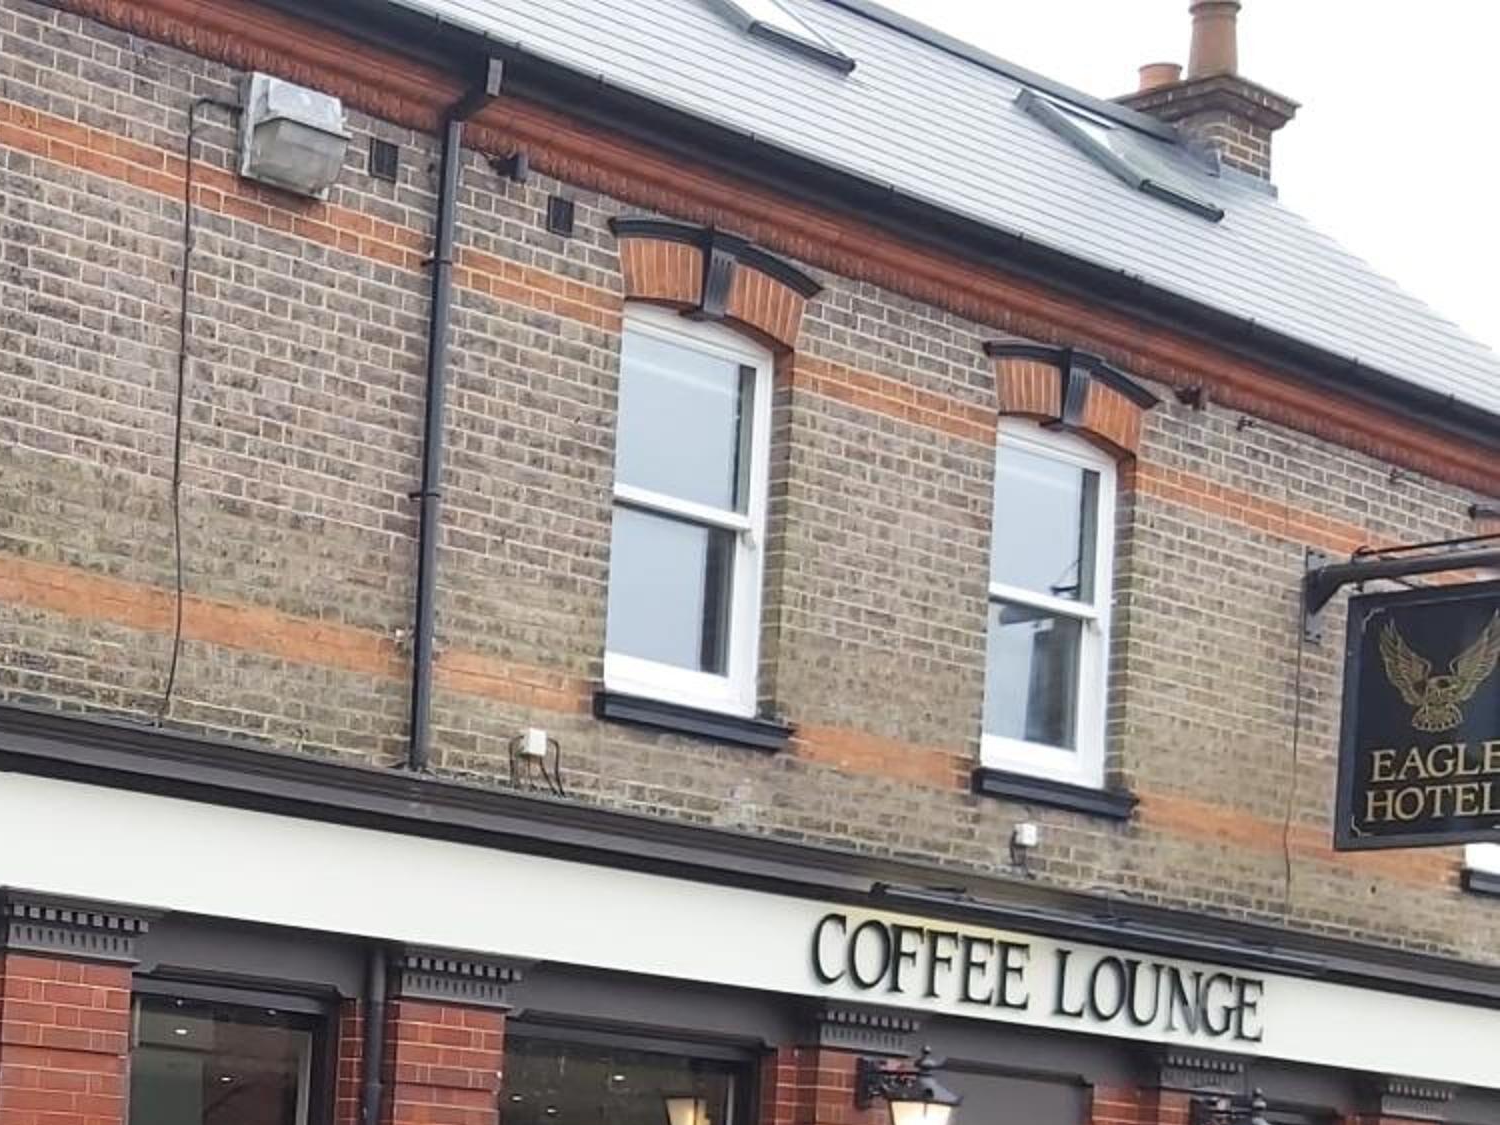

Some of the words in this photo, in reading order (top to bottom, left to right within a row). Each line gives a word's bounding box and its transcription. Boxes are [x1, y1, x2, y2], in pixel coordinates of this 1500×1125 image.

[1370, 740, 1500, 782] EAGLE
[1365, 781, 1500, 821] HOTEL
[811, 912, 1031, 1011] COFFEE
[1054, 947, 1265, 1043] LOUNGE
